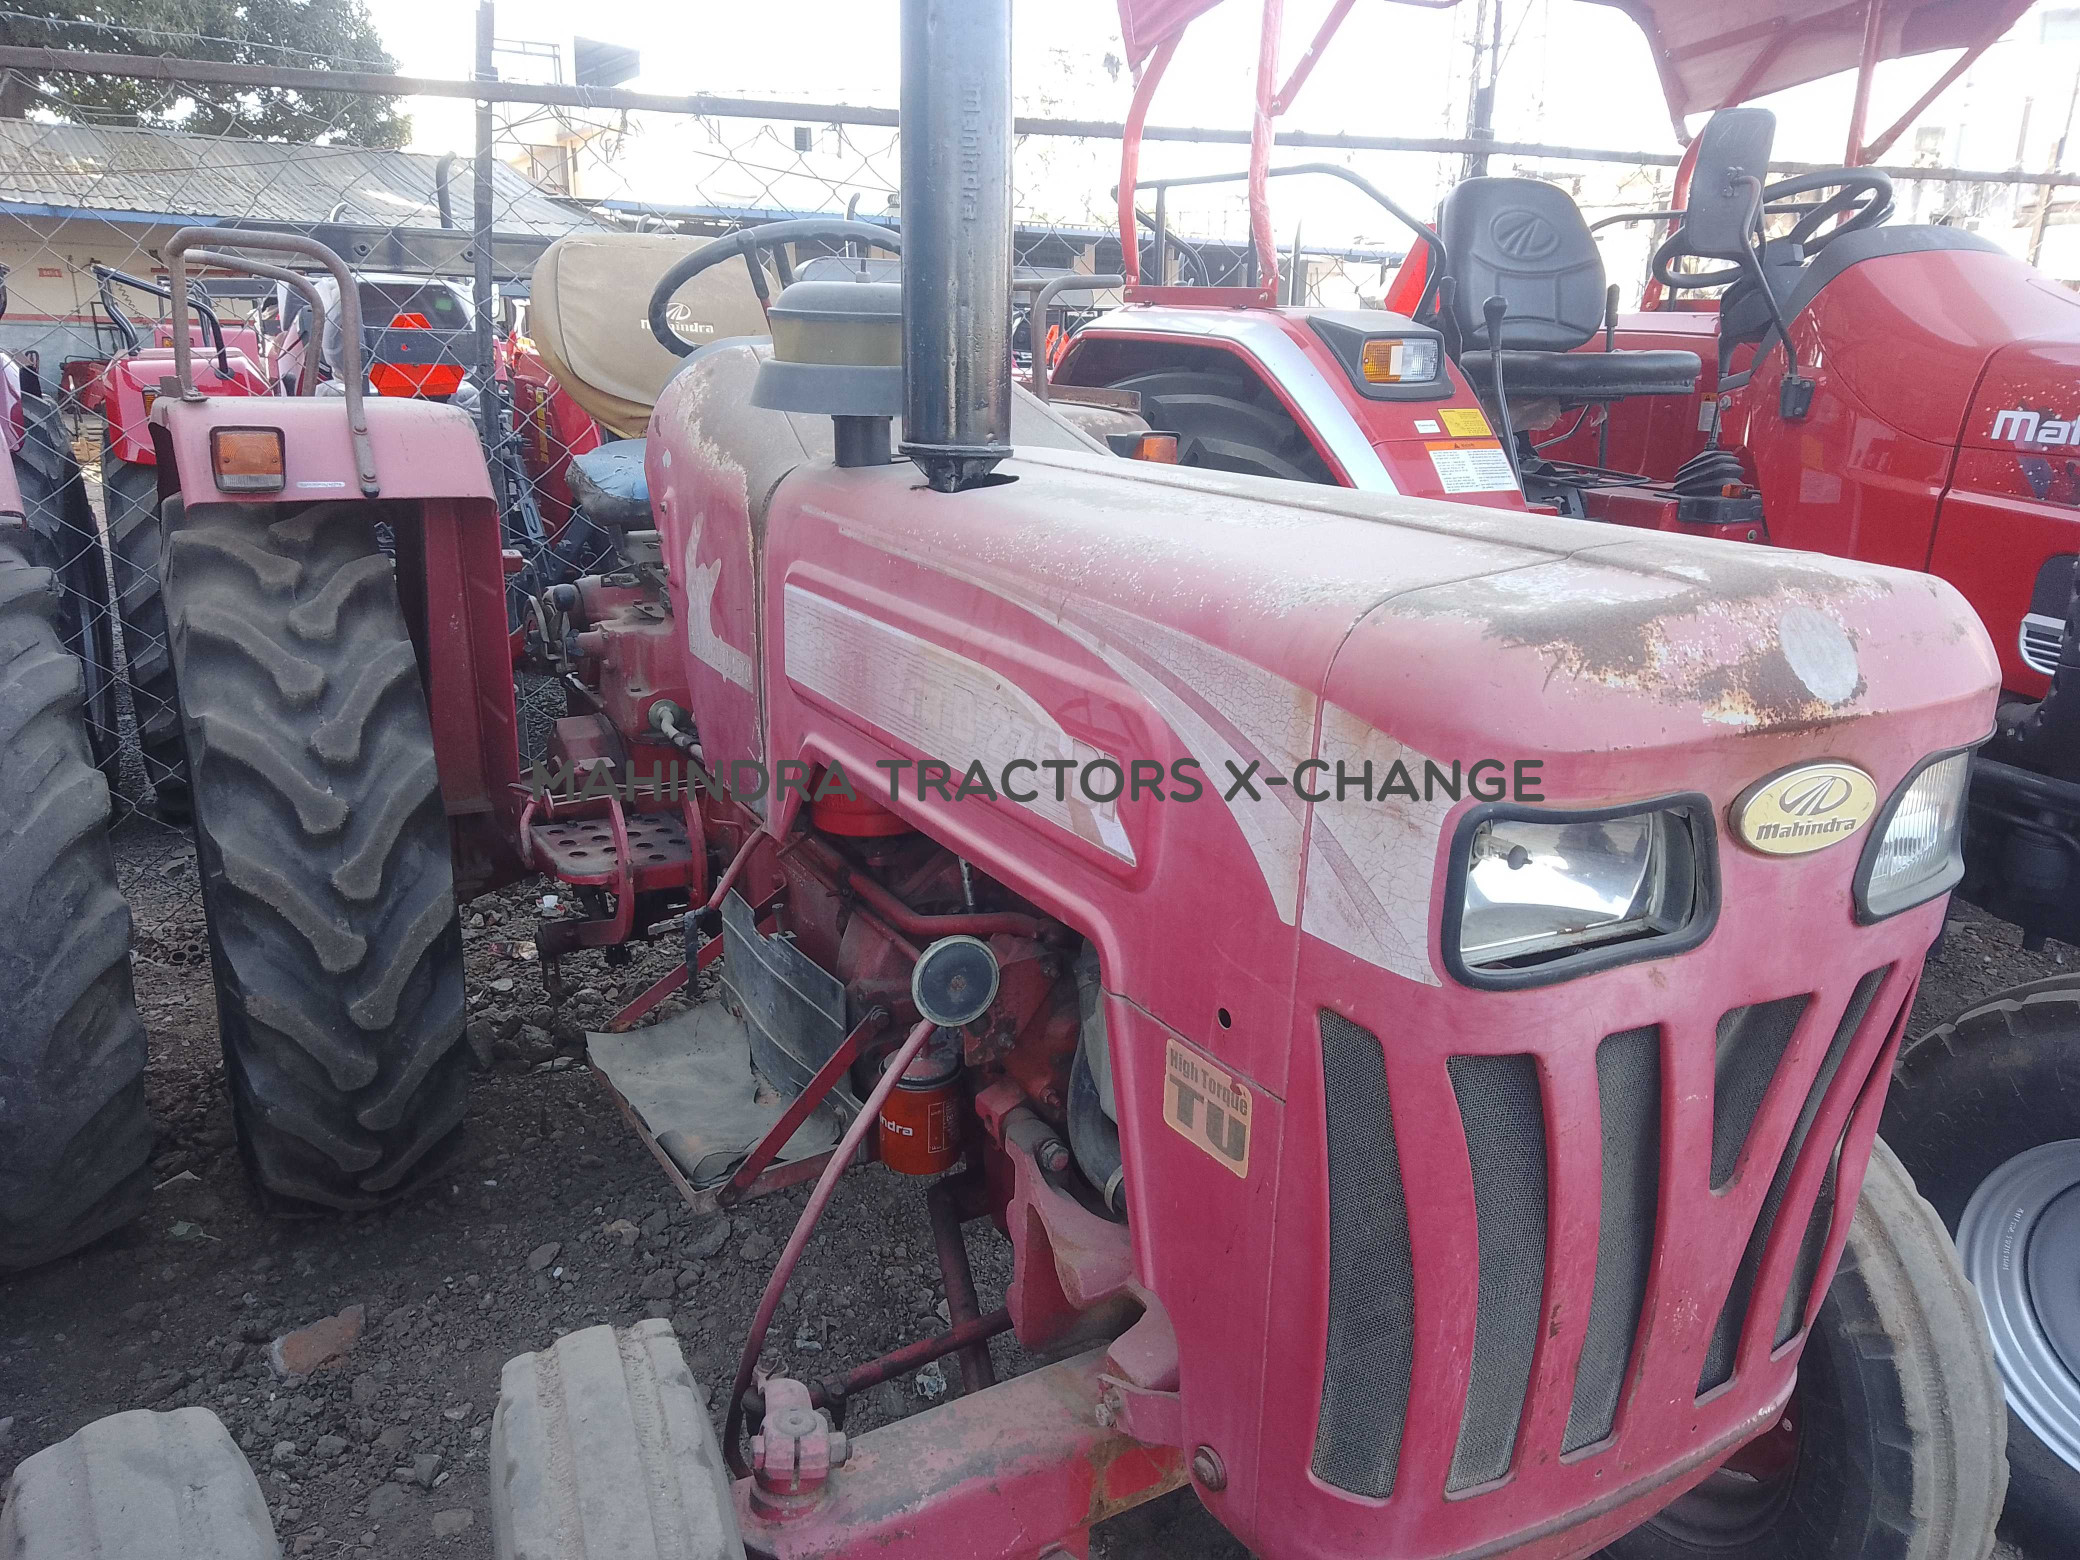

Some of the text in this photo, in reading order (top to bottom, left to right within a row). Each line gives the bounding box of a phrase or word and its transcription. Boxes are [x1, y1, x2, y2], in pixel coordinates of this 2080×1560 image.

[1169, 1073, 1247, 1162] TU
[1170, 1047, 1248, 1116] High Torque
